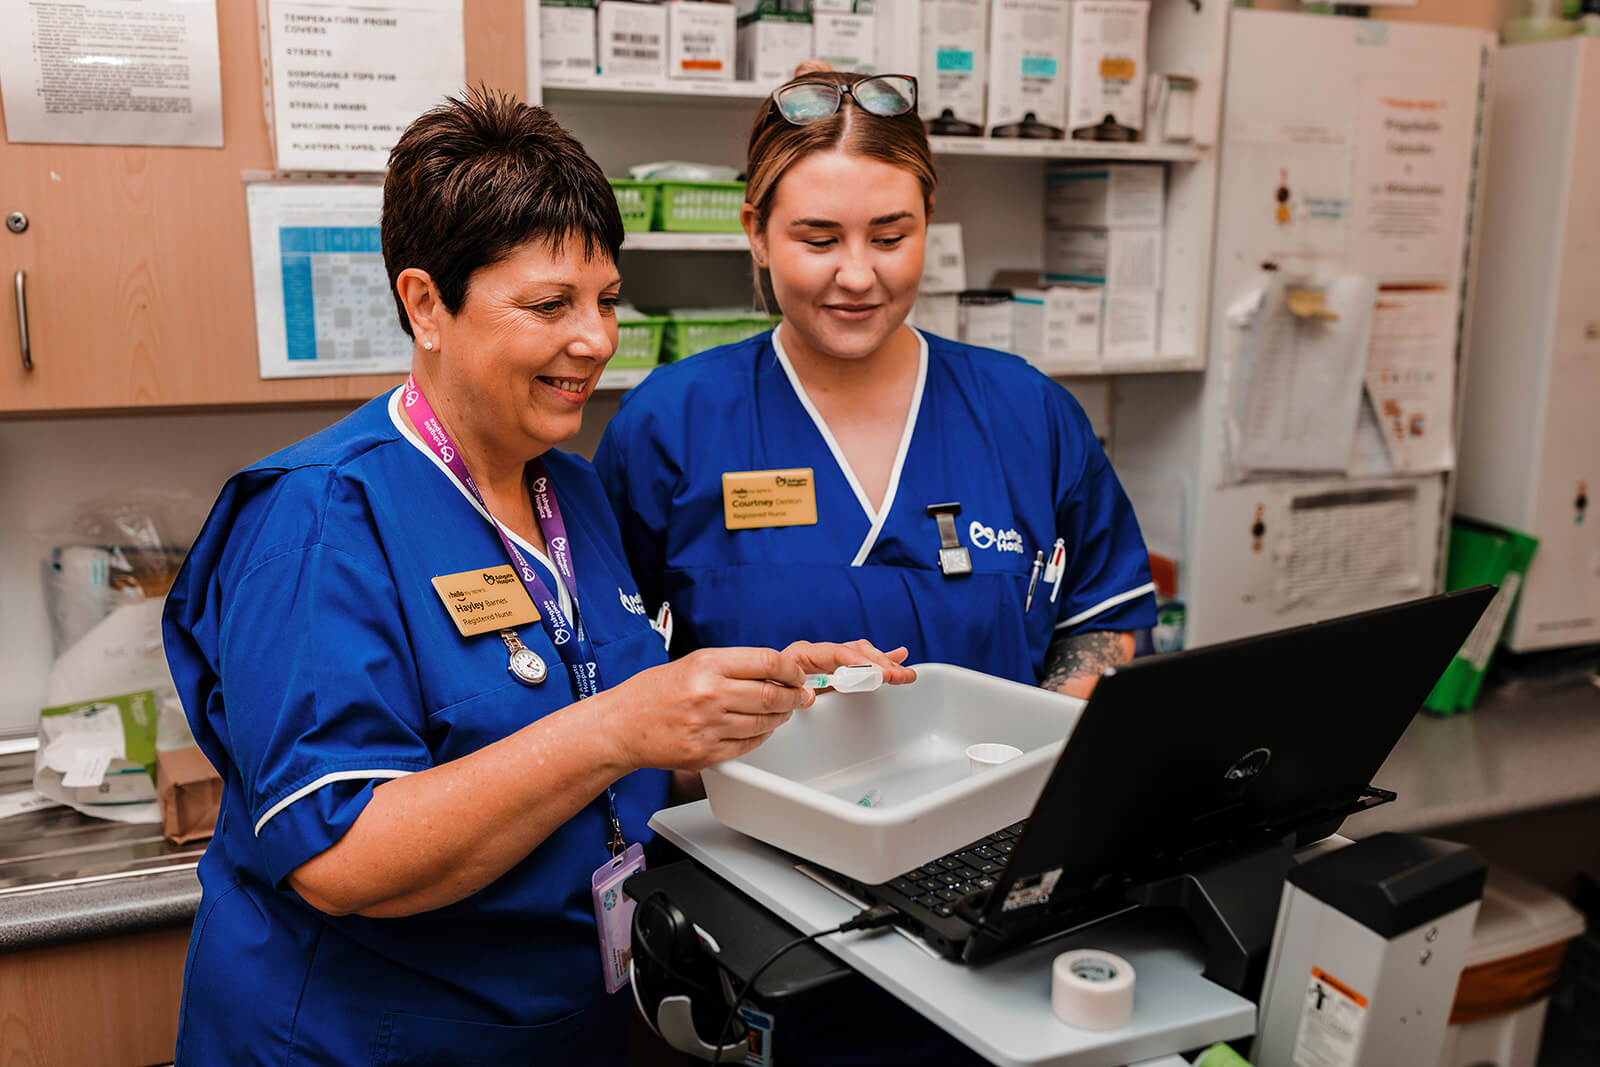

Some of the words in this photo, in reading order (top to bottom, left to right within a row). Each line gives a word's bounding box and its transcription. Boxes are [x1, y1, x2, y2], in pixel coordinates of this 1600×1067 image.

[284, 13, 360, 25] TEMPERATURE
[363, 18, 398, 26] PROBE
[284, 25, 327, 34] COVERS
[286, 48, 332, 57] STERETS
[287, 70, 349, 80] DISPOSABLE
[352, 73, 375, 81] TIPS
[287, 81, 340, 89] OTOSCOPE
[289, 101, 329, 110] STERILE
[333, 102, 368, 111] SWABS
[290, 122, 341, 131] SPECIMEN
[343, 123, 369, 132] POTS
[371, 124, 392, 132] AND
[423, 420, 443, 447] Ashgate
[429, 418, 449, 444] Hospice
[535, 493, 546, 519] Hospice
[541, 492, 553, 519] Ashgate
[731, 499, 773, 508] Courtney
[454, 600, 484, 613] Hayley
[484, 598, 508, 607] Barnes
[549, 599, 567, 627] Hospice
[462, 613, 496, 626] Registered
[495, 610, 513, 619] Nurse
[543, 600, 560, 629] Ashgate
[572, 663, 584, 693] Ashgate
[578, 663, 589, 693] Hospice
